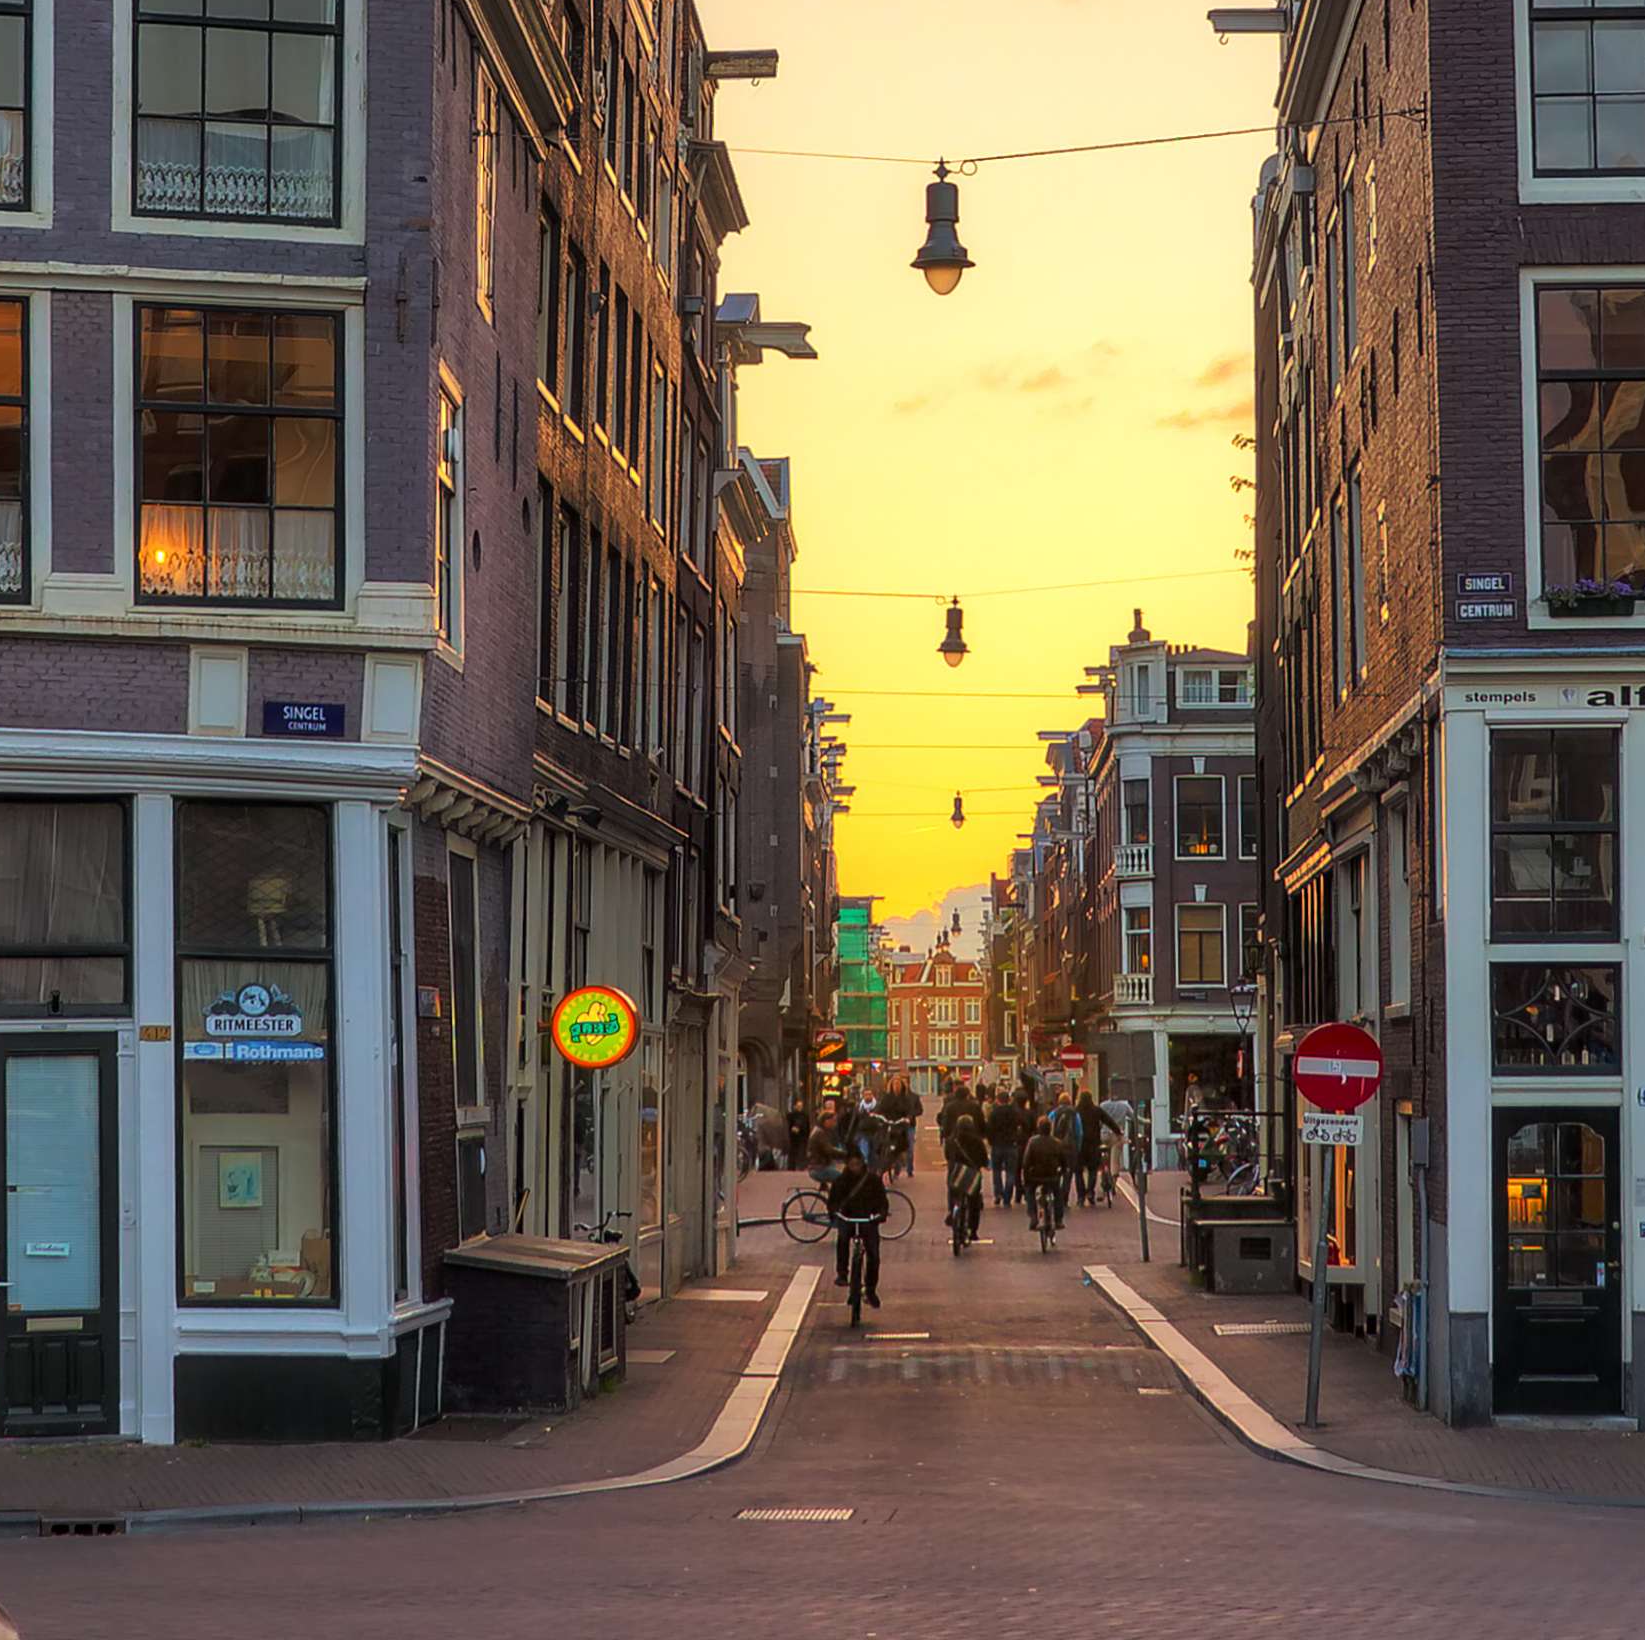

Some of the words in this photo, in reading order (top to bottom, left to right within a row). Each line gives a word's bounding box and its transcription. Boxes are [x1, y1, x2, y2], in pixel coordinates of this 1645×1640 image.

[1464, 577, 1505, 591] SINGEL
[1459, 603, 1513, 617] CENTRUM
[1464, 691, 1536, 705] stempels
[283, 705, 326, 721] SINGEL
[287, 721, 326, 731] CENTRUM
[214, 1018, 294, 1032] RITMEESTER
[236, 1044, 325, 1060] Rothmans
